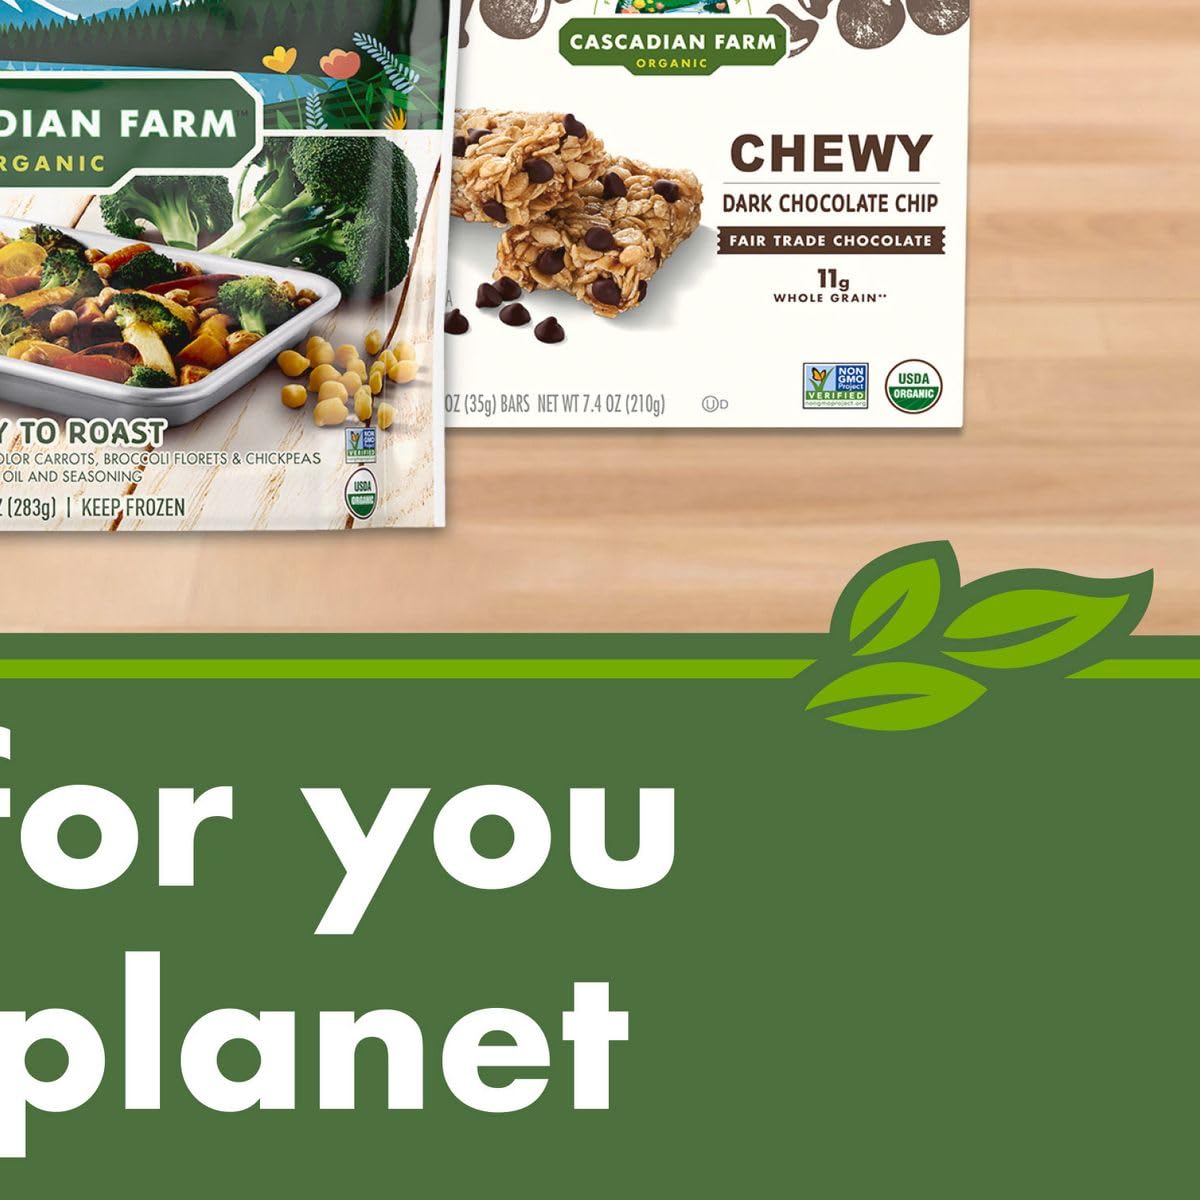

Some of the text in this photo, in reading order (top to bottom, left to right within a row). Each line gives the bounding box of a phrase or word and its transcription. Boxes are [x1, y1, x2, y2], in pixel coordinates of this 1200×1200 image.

[570, 34, 705, 50] CASCADIAN
[636, 58, 707, 68] ORGANIC
[731, 133, 933, 172] CHEWY
[723, 193, 938, 213] DARK CHOCOLATE CHIP
[730, 235, 932, 247] FAIR TRADE CHOCOLATE
[817, 268, 850, 292] 11g
[773, 294, 823, 303] WHOLE
[838, 367, 864, 375] NON
[838, 375, 864, 383] GMO
[898, 372, 930, 384] USDA
[838, 383, 864, 391] Project
[894, 388, 935, 399] ORGANIC
[445, 393, 666, 417] OZ (35g) BARS NET WT 7.4 OZ (210g)
[20, 421, 56, 444] TO
[69, 421, 165, 444] ROAST
[34, 453, 99, 467] CARROTS,
[104, 453, 169, 465] BROCCOLI
[174, 453, 227, 465] FLORETS
[232, 453, 241, 465] &
[245, 453, 321, 465] CHICKPEAS
[3, 471, 23, 483] OIL
[28, 471, 58, 483] AND
[62, 471, 143, 483] SEASONING
[354, 481, 371, 492] USDA
[7, 497, 56, 520] (283g)
[82, 498, 120, 516] KEEP
[126, 498, 185, 516] FROZEN
